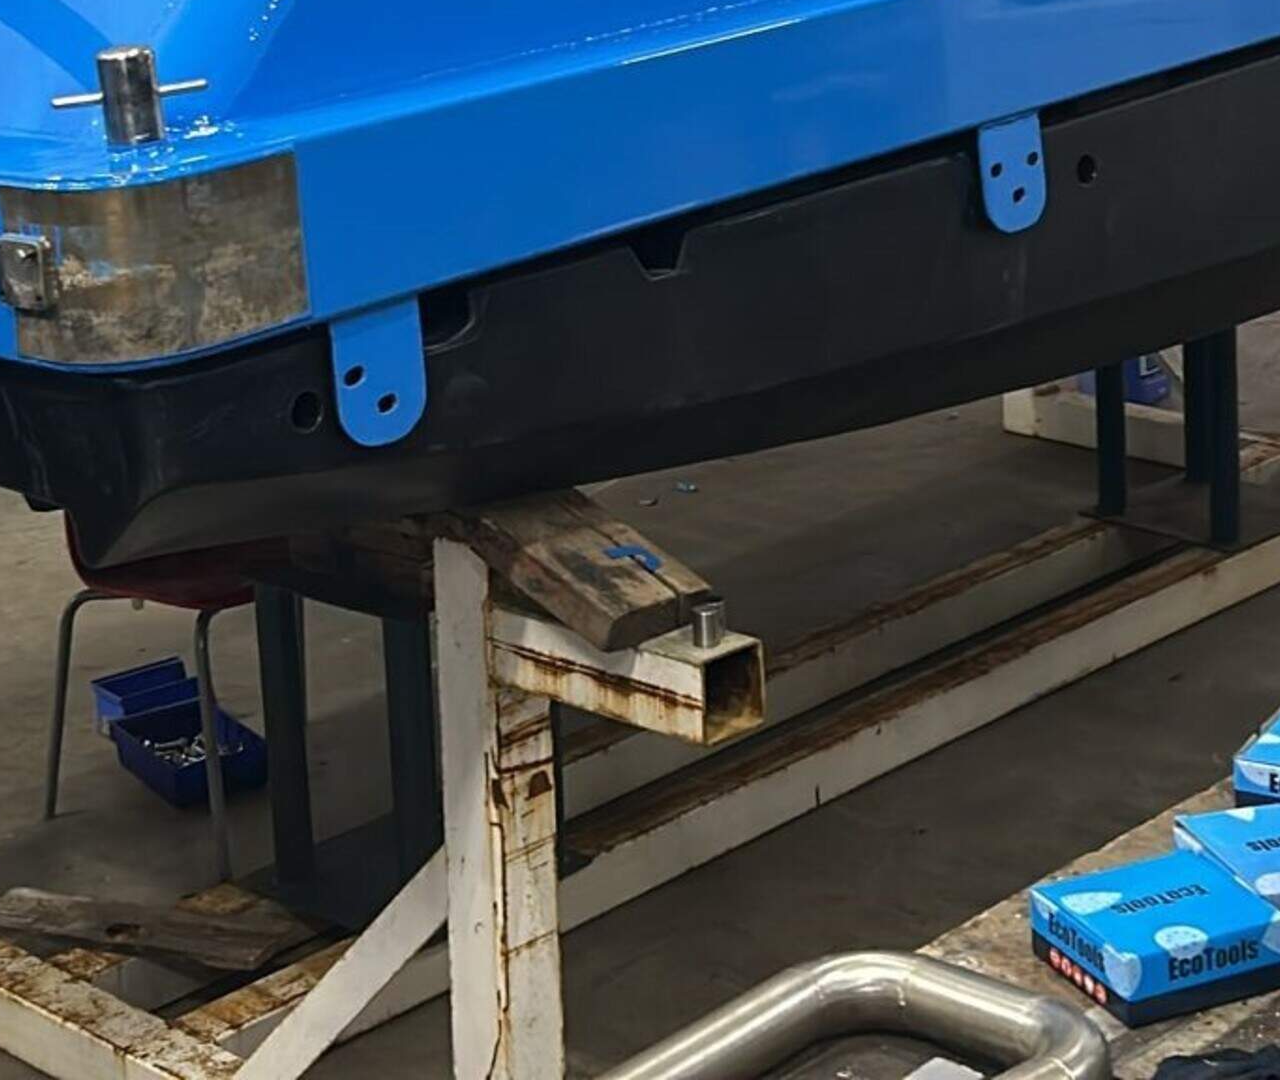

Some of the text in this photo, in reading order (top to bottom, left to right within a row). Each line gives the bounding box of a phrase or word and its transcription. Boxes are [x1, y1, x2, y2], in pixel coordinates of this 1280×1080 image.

[1110, 884, 1210, 915] EcoTools
[1048, 912, 1106, 974] EcoTools
[1168, 938, 1260, 982] EcoTools
